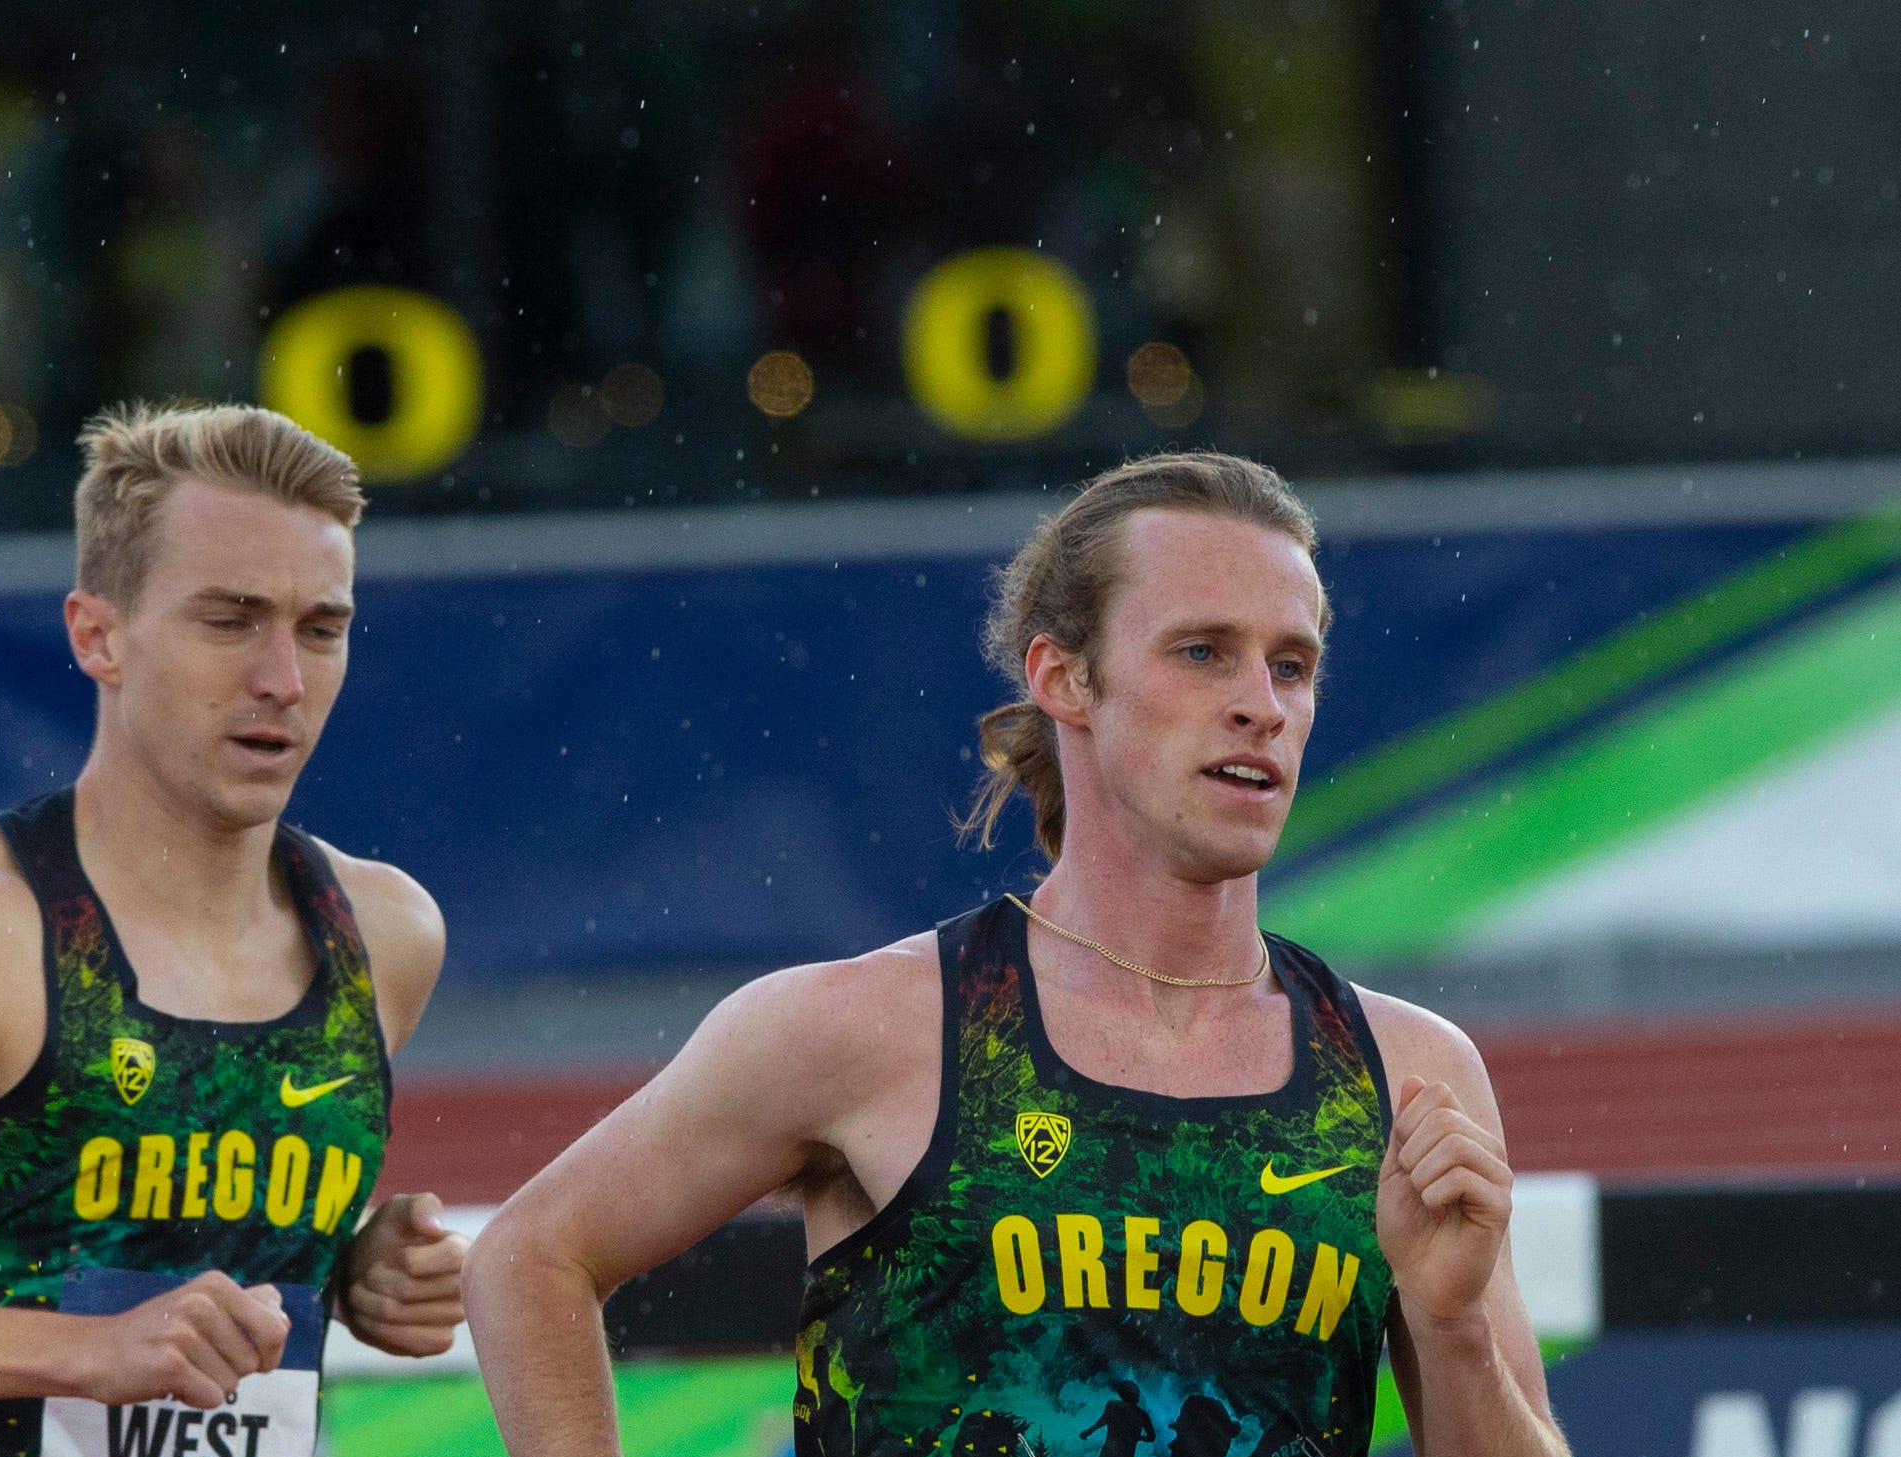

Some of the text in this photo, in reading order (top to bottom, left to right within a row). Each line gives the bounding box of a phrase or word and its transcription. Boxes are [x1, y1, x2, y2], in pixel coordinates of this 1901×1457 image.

[121, 1066, 144, 1090] 12
[1019, 1115, 1068, 1153] PAC
[1030, 1139, 1056, 1164] 12
[72, 1128, 363, 1237] OREGON
[990, 1213, 1361, 1342] OREGON
